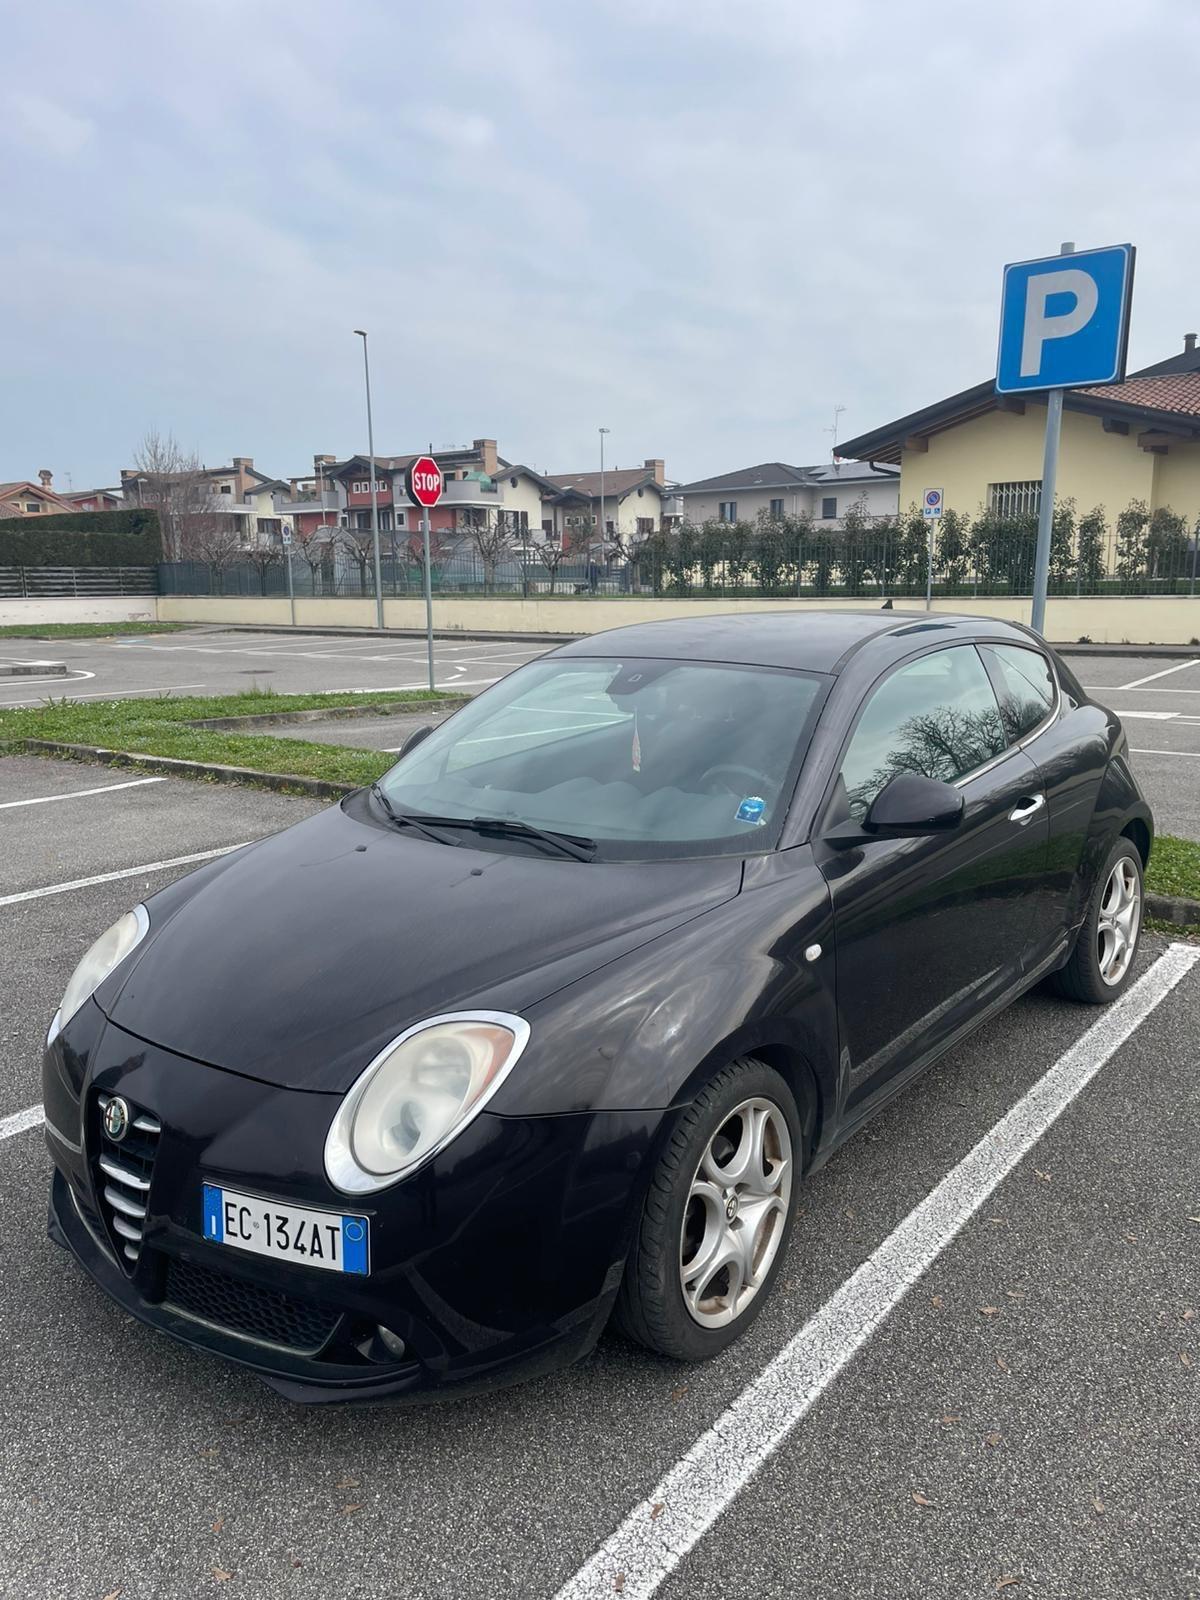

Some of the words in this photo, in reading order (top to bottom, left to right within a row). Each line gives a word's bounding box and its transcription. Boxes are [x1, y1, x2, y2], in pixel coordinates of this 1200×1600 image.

[1020, 269, 1098, 377] P
[414, 472, 440, 492] STOP
[225, 1202, 252, 1240] EC
[263, 1213, 340, 1260] 134AT
